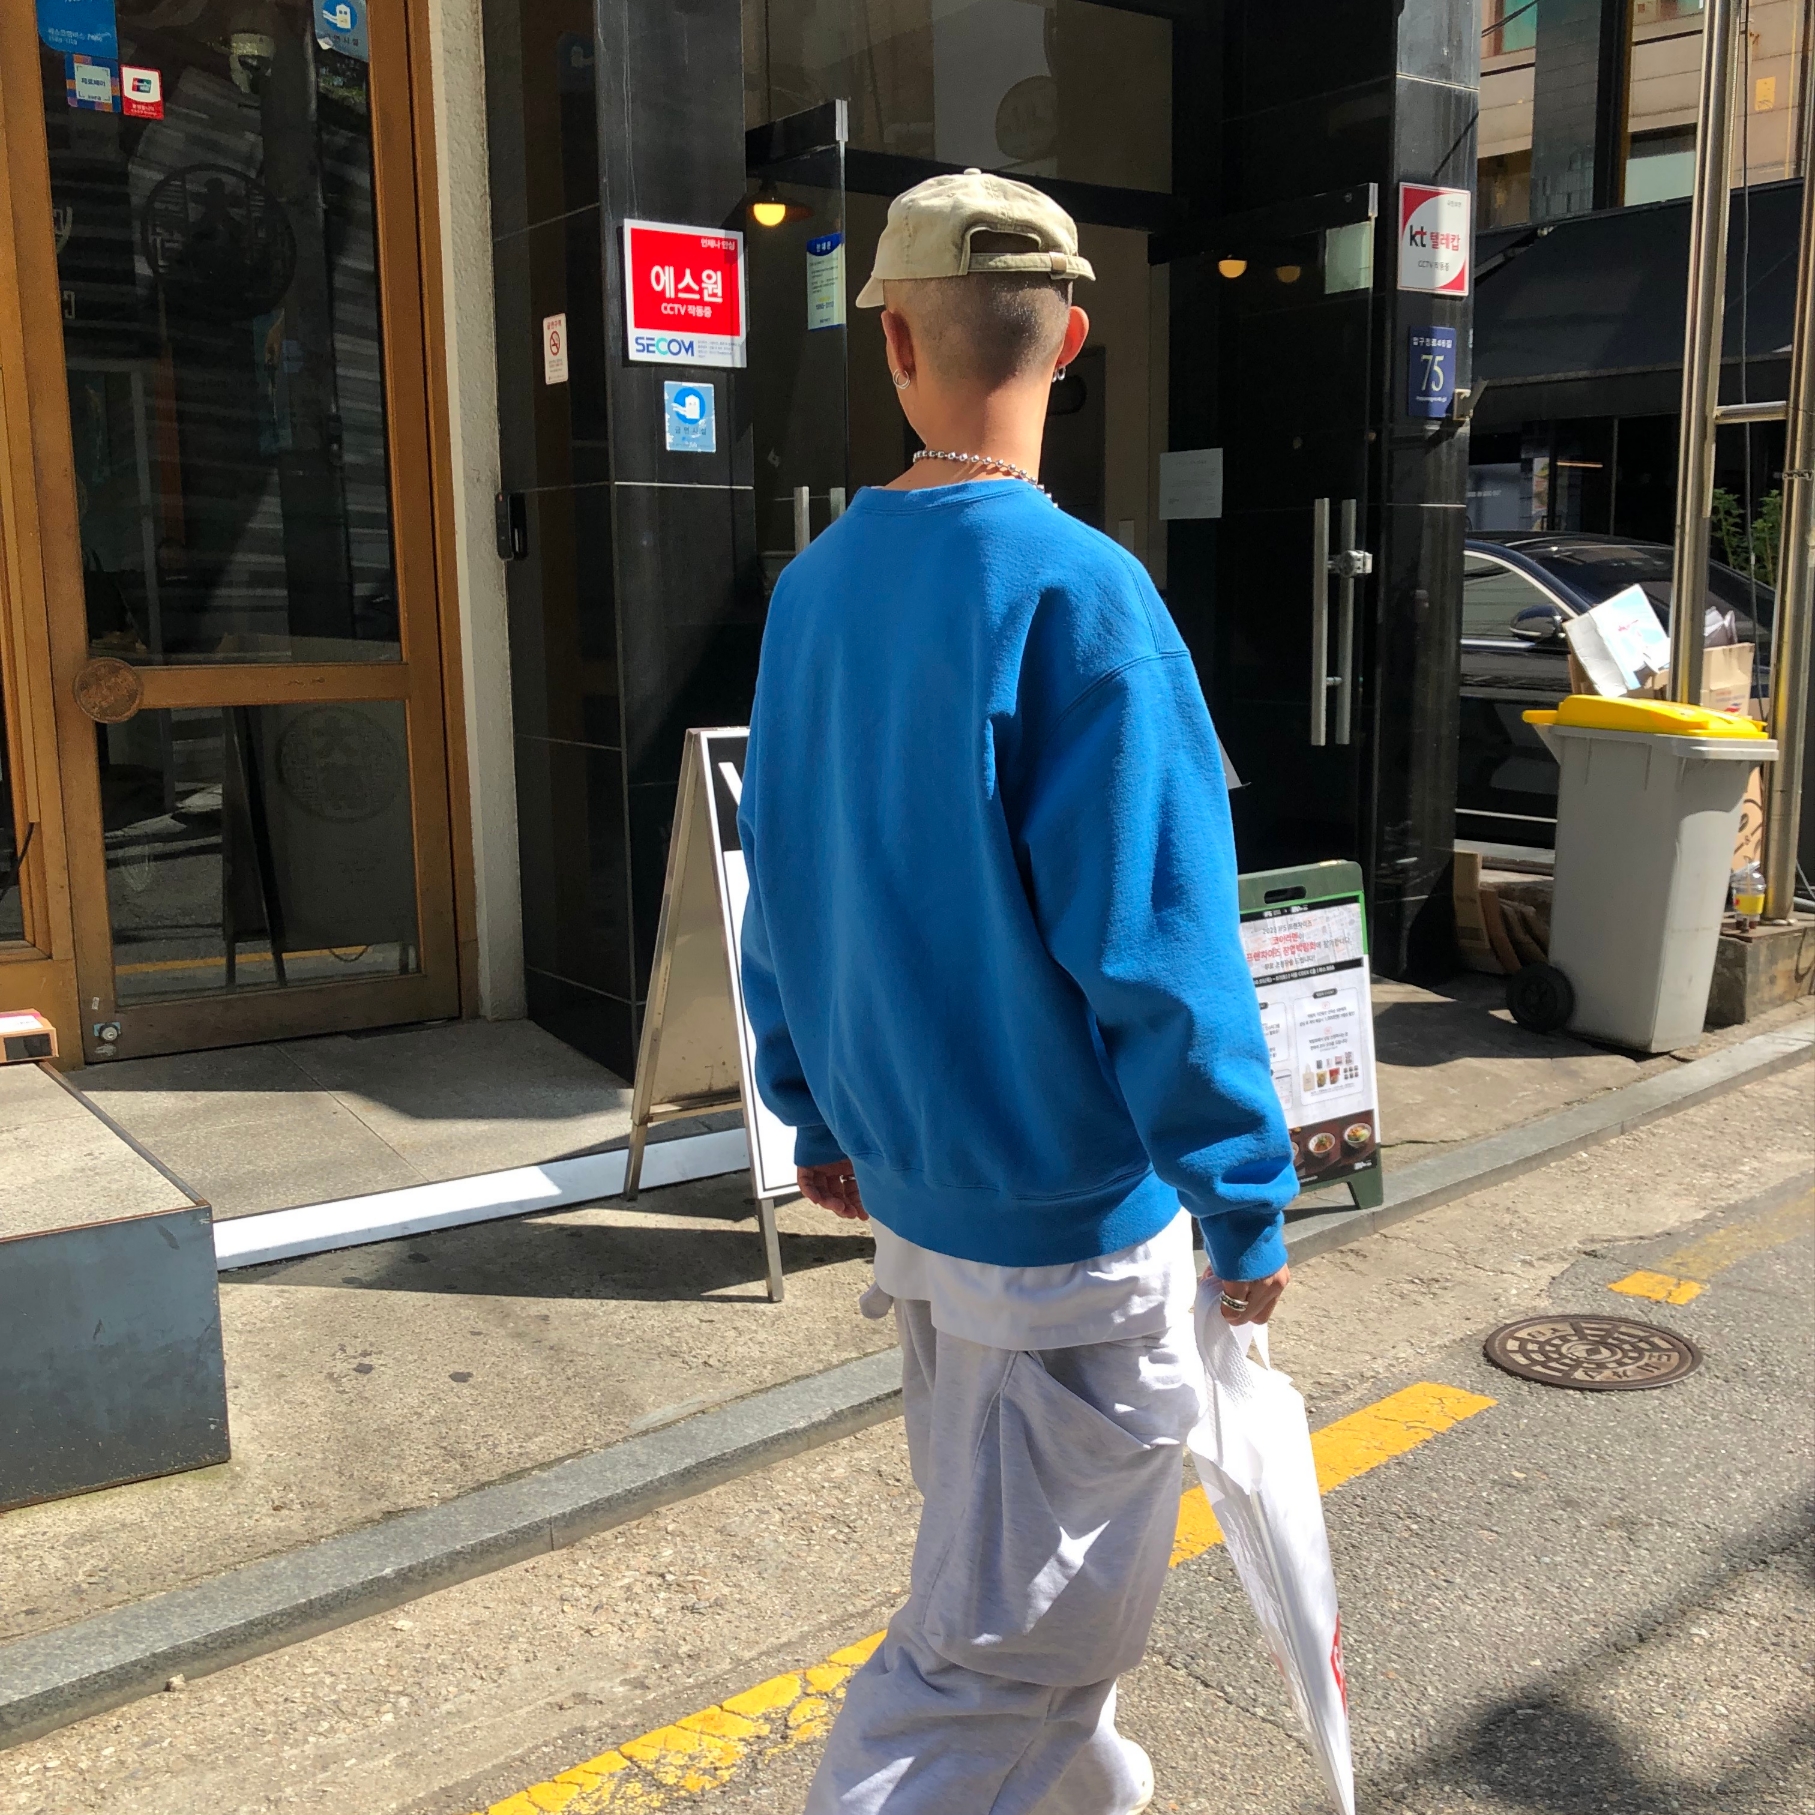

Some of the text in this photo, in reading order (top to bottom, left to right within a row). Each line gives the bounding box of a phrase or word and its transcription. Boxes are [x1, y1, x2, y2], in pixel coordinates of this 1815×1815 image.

[701, 237, 721, 249] 언제나
[1409, 224, 1460, 252] kt 텔레캅
[1417, 259, 1434, 269] CCTV
[650, 264, 723, 303] 에스원
[661, 302, 713, 319] CCTV 작동중
[634, 336, 695, 357] SECOM
[1420, 354, 1445, 392] 75
